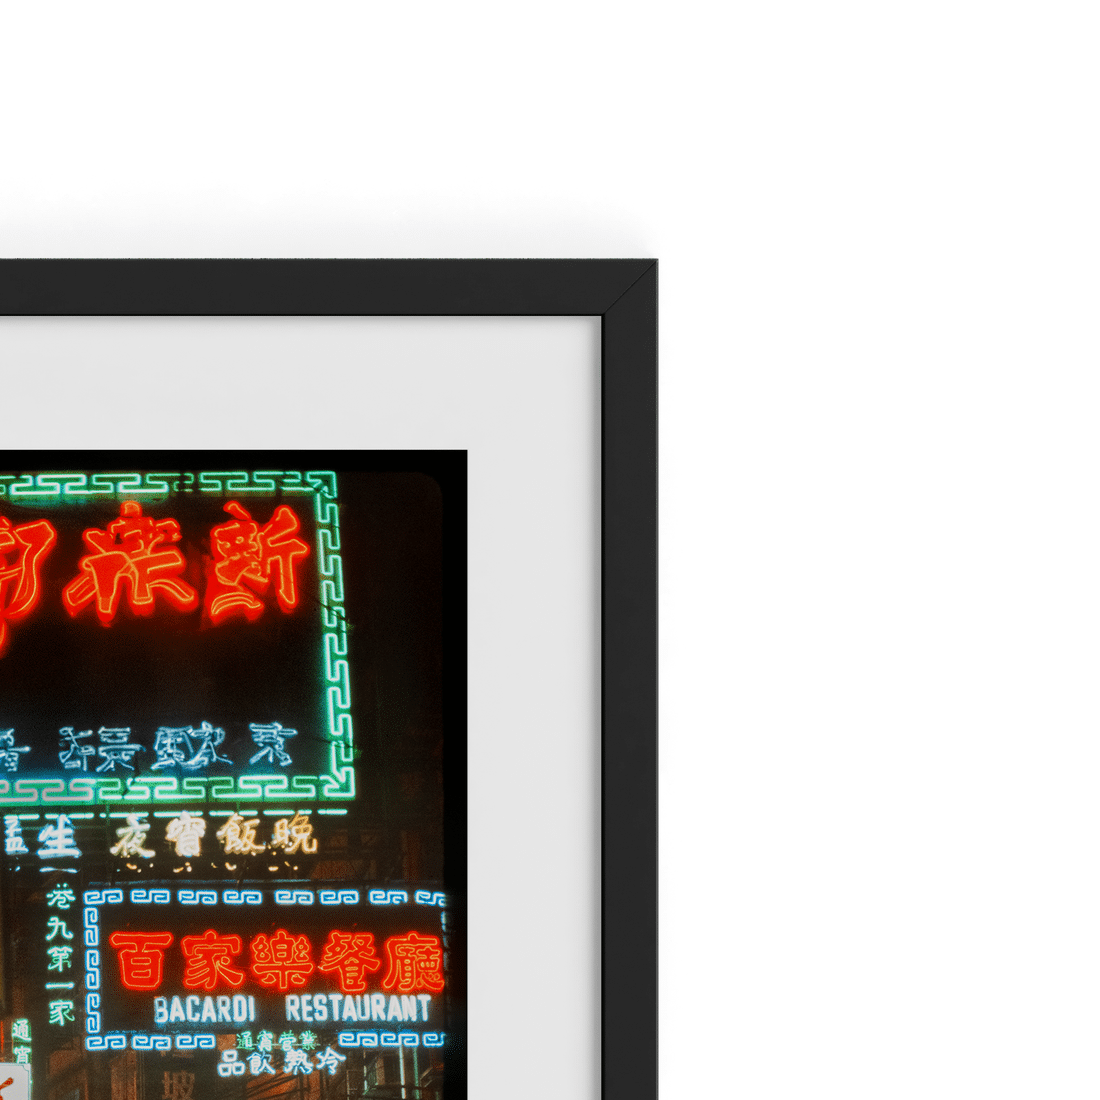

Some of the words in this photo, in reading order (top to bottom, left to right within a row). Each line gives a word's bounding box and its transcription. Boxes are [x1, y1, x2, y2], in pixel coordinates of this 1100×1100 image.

[109, 930, 445, 993] 百家樂餐廳
[154, 995, 256, 1024] BACARDI
[285, 994, 431, 1022] RESTAURANT
